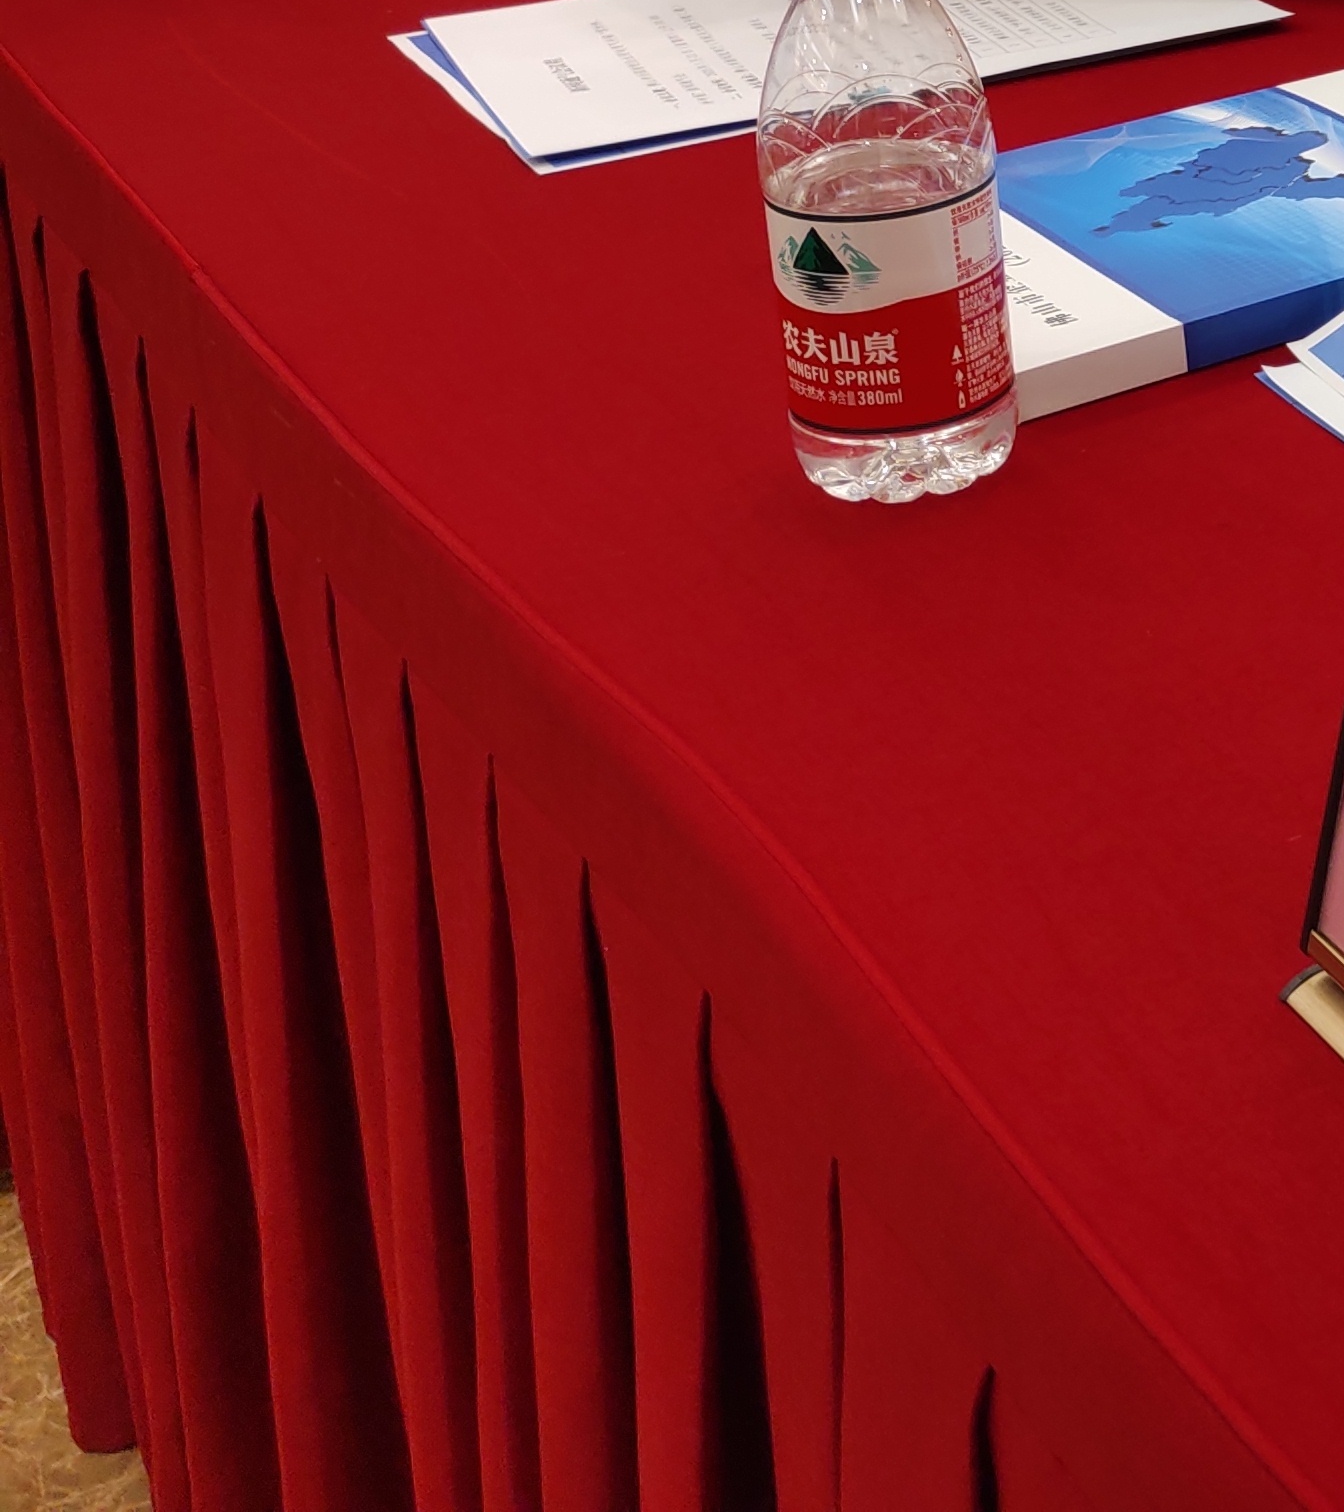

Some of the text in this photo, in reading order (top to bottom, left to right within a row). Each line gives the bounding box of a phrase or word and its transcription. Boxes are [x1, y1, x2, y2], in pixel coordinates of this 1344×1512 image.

[782, 319, 899, 366] 农夫山泉
[834, 369, 900, 387] SPRING
